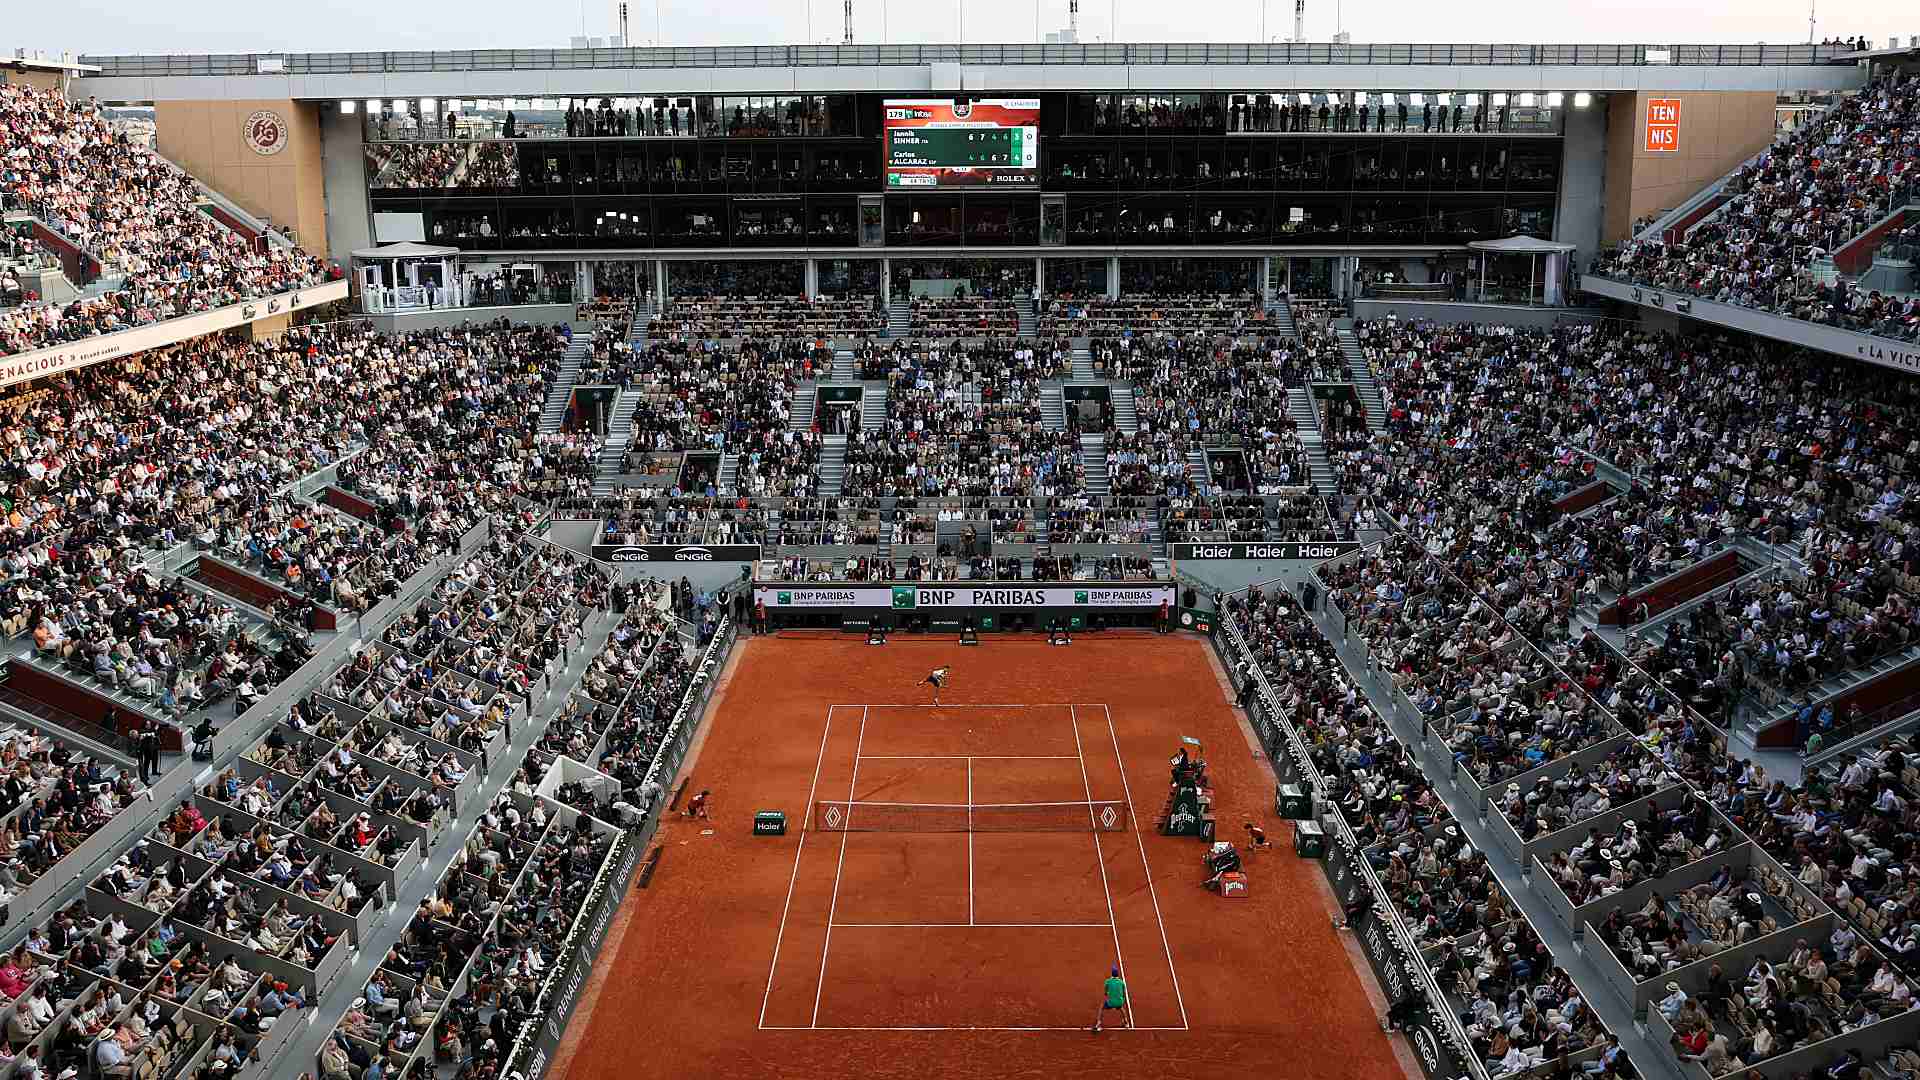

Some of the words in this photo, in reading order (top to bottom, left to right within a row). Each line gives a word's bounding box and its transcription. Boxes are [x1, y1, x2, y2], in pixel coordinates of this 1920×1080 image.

[1652, 105, 1675, 120] TEN
[1651, 129, 1673, 144] NIS
[1870, 345, 1883, 360] LA
[1192, 545, 1232, 558] Haier
[1245, 545, 1286, 558] Haier
[1298, 545, 1338, 557] Haier
[794, 592, 813, 600] BNP
[815, 592, 855, 600] PARIBAS
[920, 591, 954, 604] BNP
[973, 591, 1045, 604] PARIBAS
[1091, 591, 1110, 600] BNP
[1113, 591, 1152, 600] PARIBAS
[757, 822, 780, 830] Haier
[617, 847, 637, 888] RENAULT
[589, 900, 612, 948] RENAULT
[557, 964, 583, 1020] RENAULT
